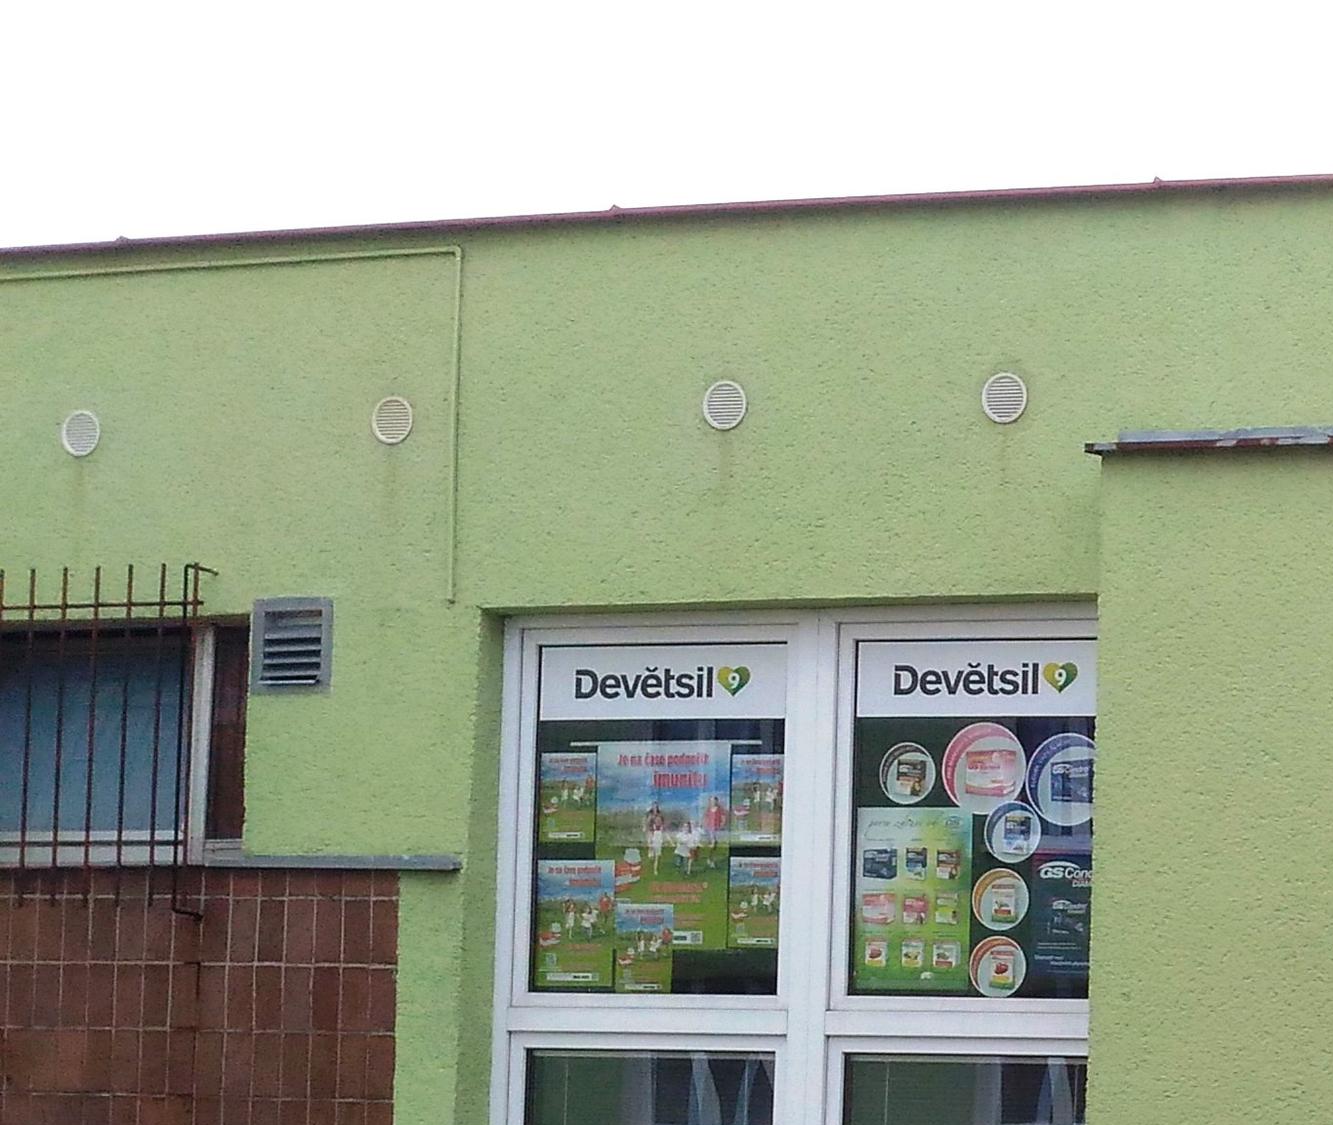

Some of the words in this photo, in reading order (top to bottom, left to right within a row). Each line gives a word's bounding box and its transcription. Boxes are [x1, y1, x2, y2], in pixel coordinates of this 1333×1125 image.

[574, 665, 714, 699] Devětsil
[893, 661, 1039, 696] Devětsil
[1039, 866, 1065, 879] GS
